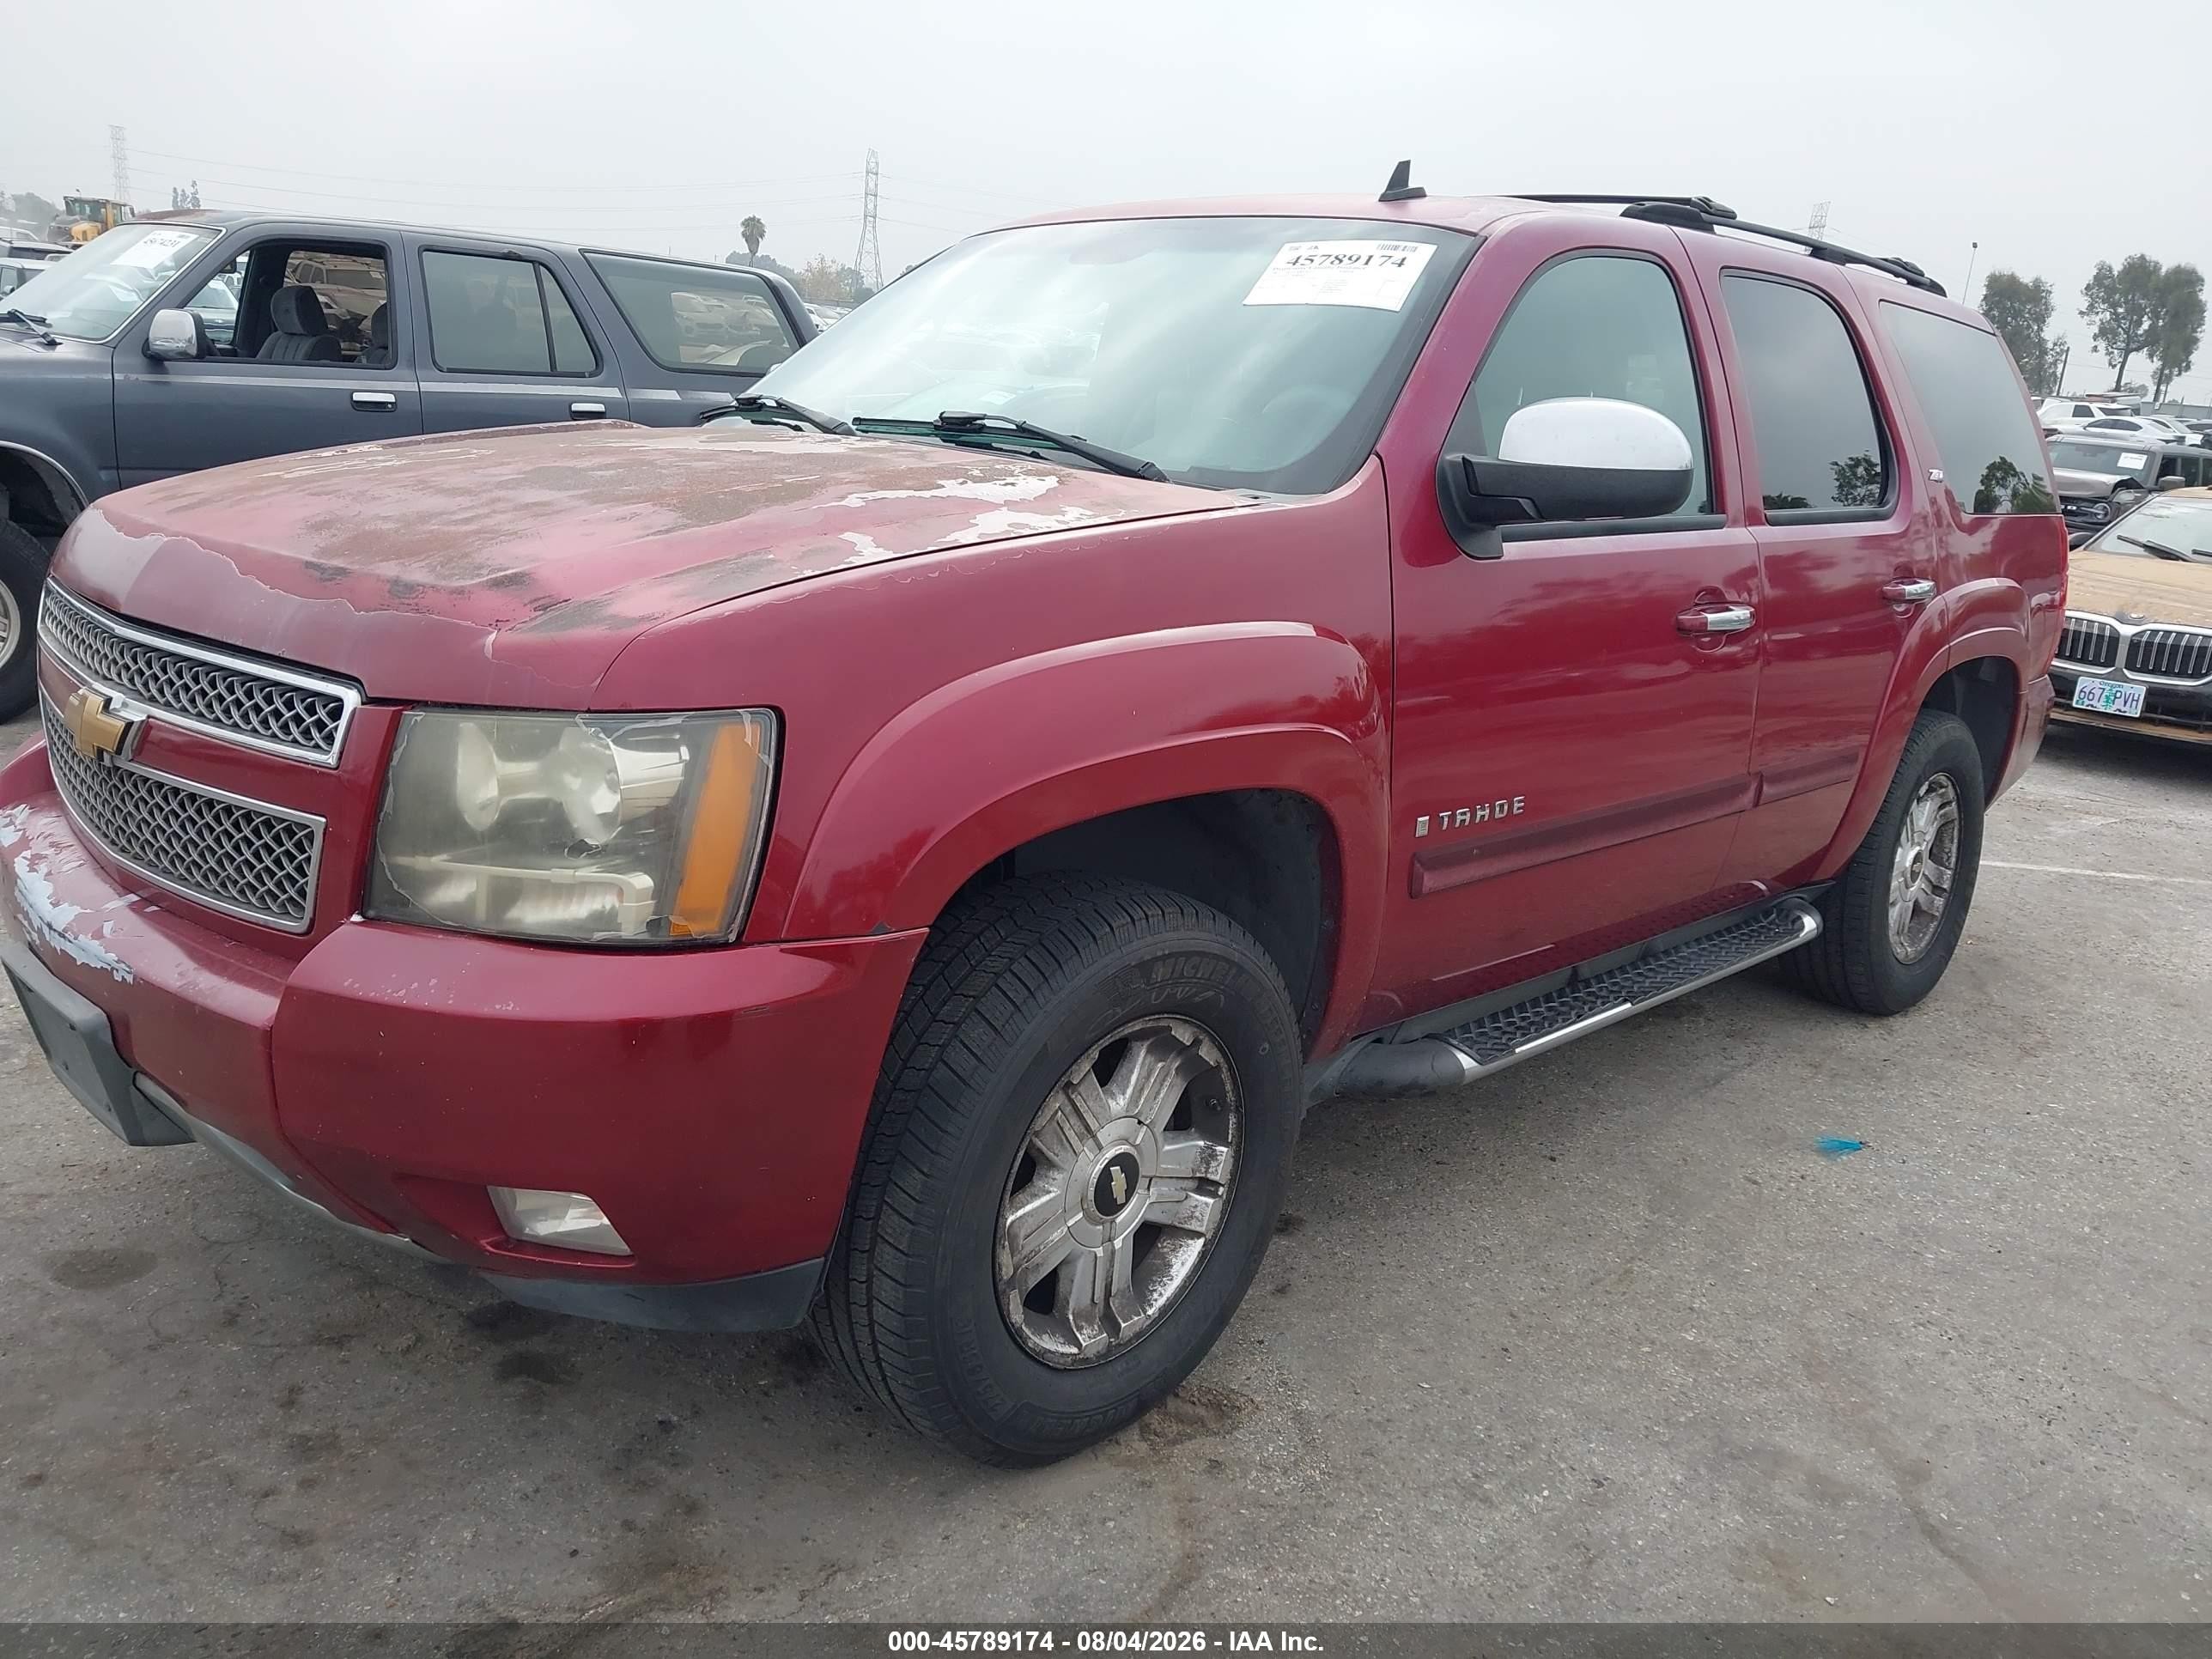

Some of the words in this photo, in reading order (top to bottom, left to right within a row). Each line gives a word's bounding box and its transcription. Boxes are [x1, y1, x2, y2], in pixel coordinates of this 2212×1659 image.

[1286, 254, 1407, 268] 45789174
[2078, 685, 2106, 703] 667
[2112, 690, 2141, 709] PVH
[1439, 796, 1525, 830] TAHOE
